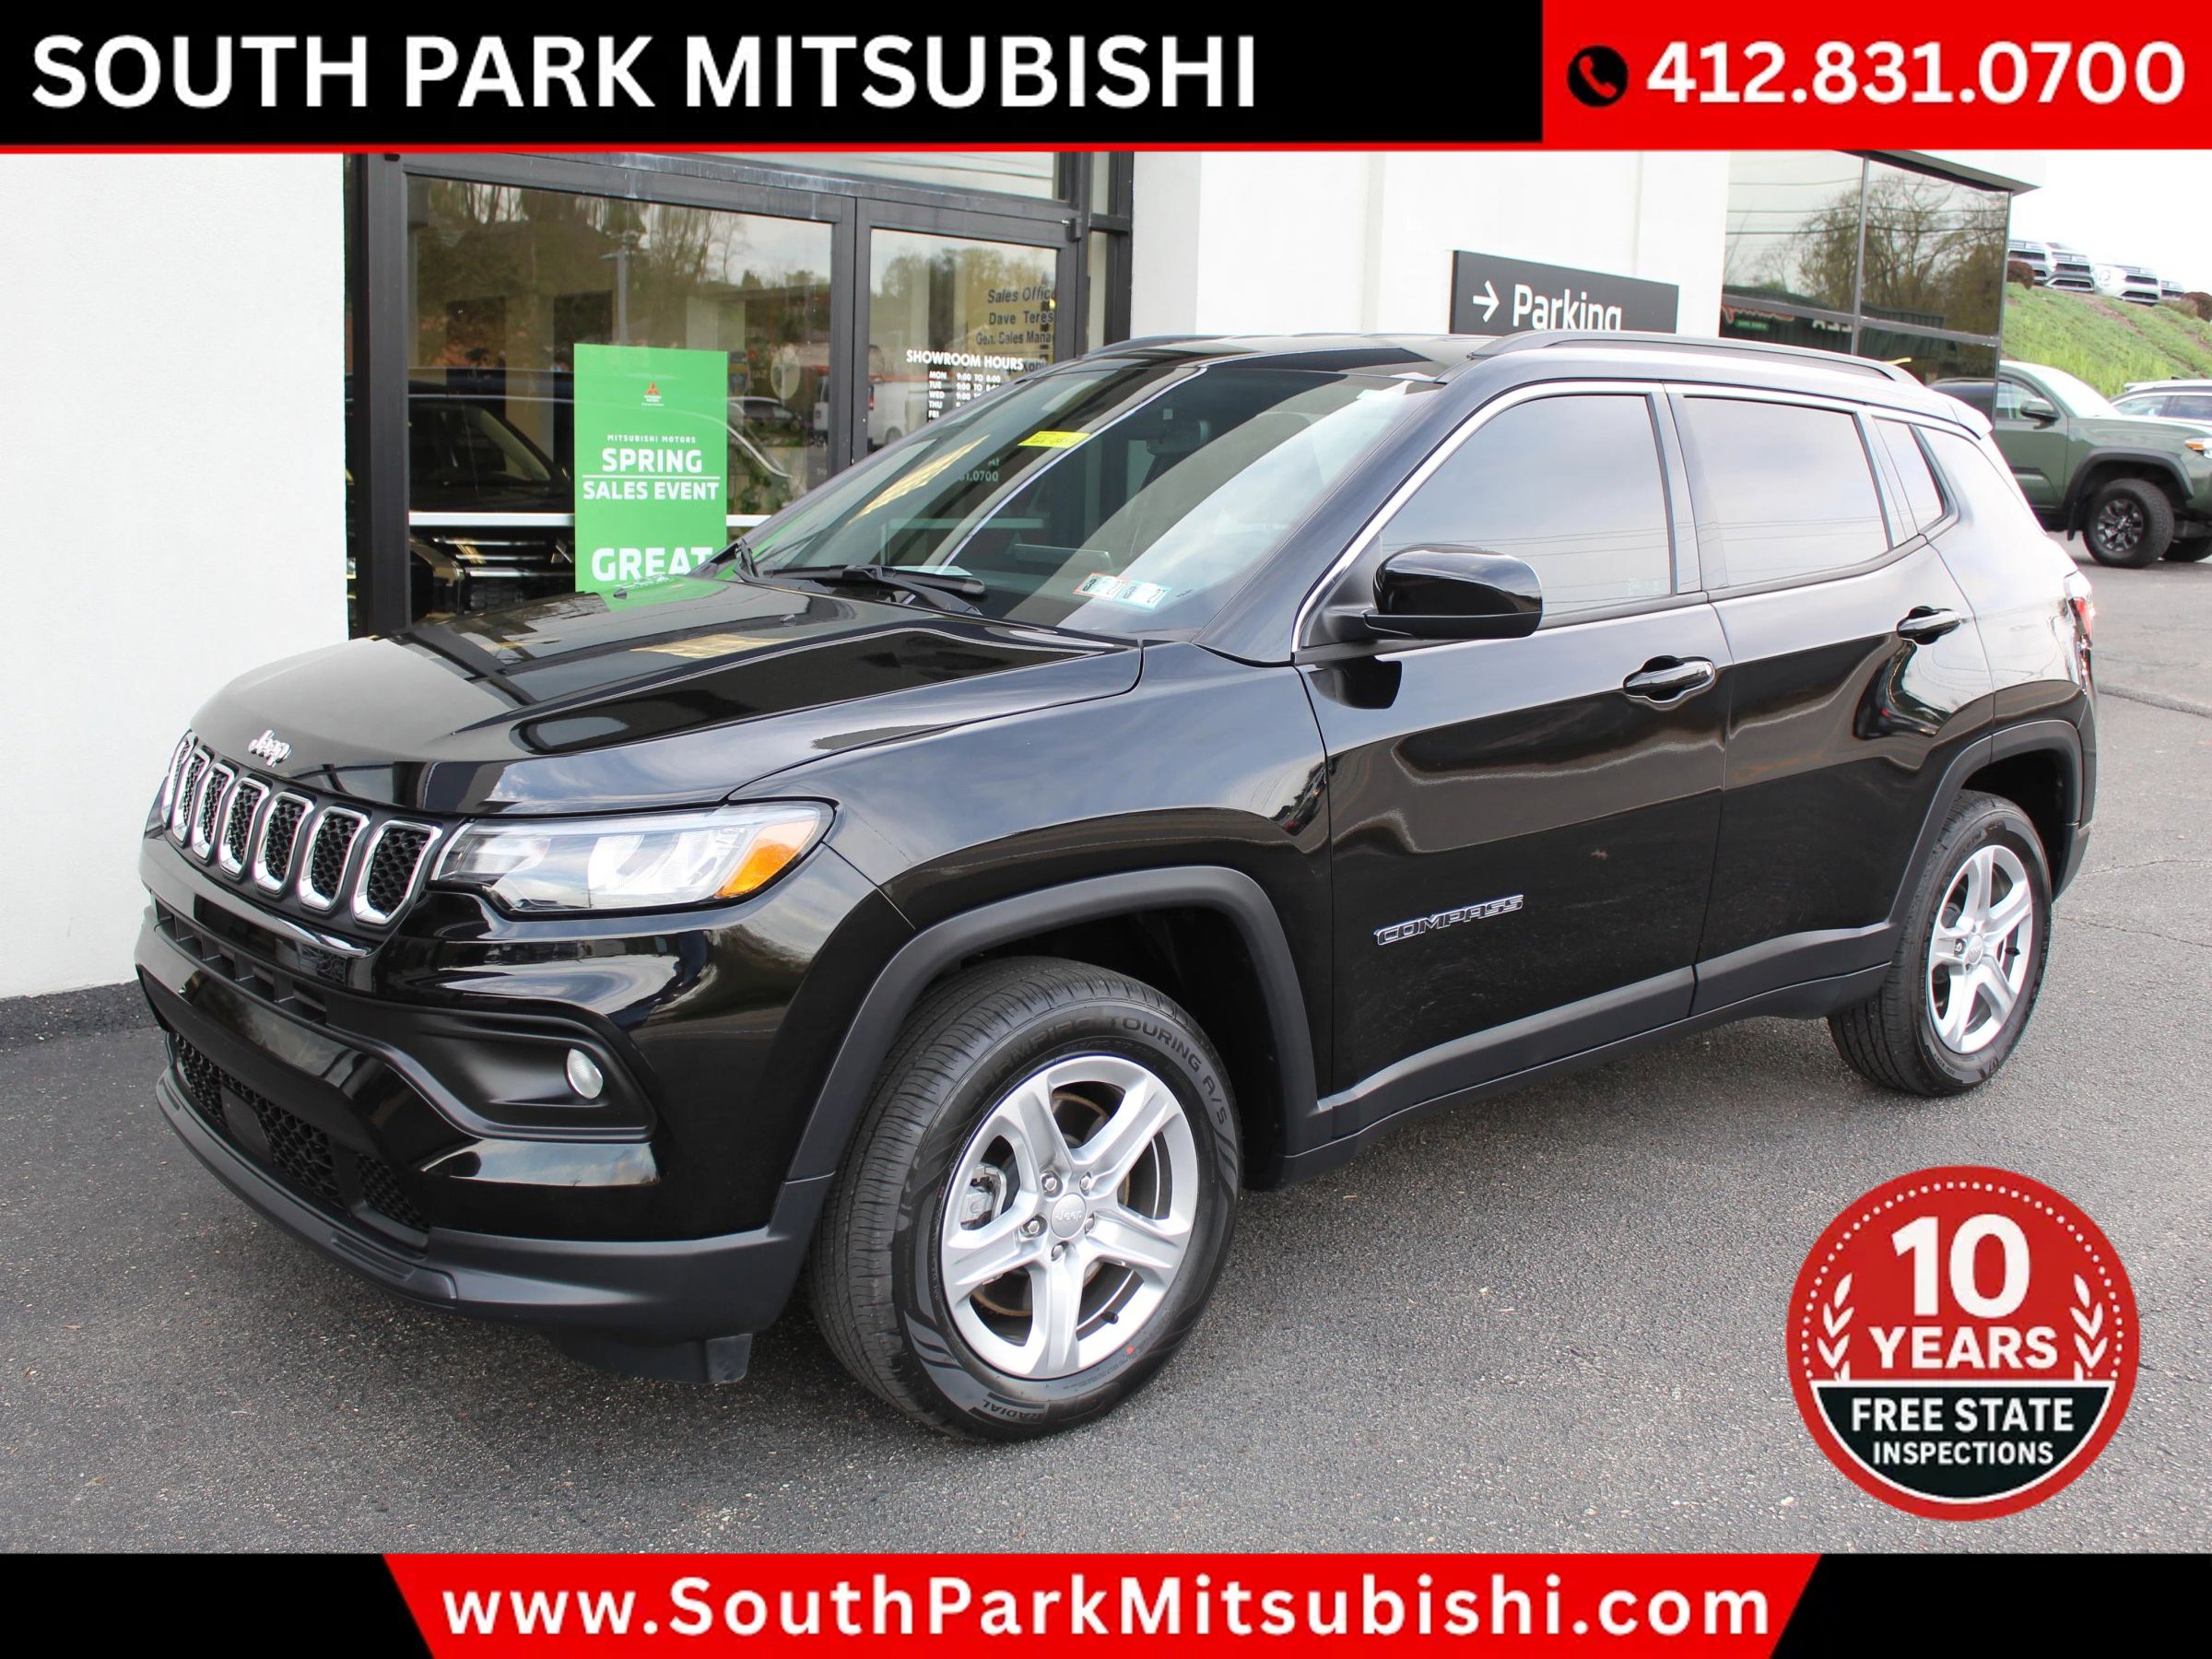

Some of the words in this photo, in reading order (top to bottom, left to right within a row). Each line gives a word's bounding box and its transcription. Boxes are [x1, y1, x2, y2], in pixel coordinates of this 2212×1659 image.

[987, 288, 1018, 303] Sales
[1512, 284, 1622, 331] Parking
[989, 312, 1016, 325] Dave
[999, 331, 1023, 345] Sales
[906, 349, 982, 368] SHOWROOM
[984, 356, 1025, 371] HOURS
[929, 371, 947, 380] MON
[974, 373, 984, 382] TO
[929, 381, 942, 389] TUE
[929, 390, 945, 399] WED
[928, 400, 943, 409] THU
[928, 410, 940, 418] FRI
[606, 433, 659, 443] MITSUBISHI
[662, 435, 697, 444] MOTORS
[602, 448, 702, 474] SPRING
[582, 481, 649, 500] SALES
[653, 481, 720, 500] EVENT
[591, 547, 713, 582] GREAT
[248, 729, 291, 767] Jeep
[1373, 894, 1524, 947] COMPASS
[1106, 1015, 1204, 1072] TOURING
[1202, 1075, 1229, 1125] A/S
[981, 1398, 1043, 1422] RADIAL
